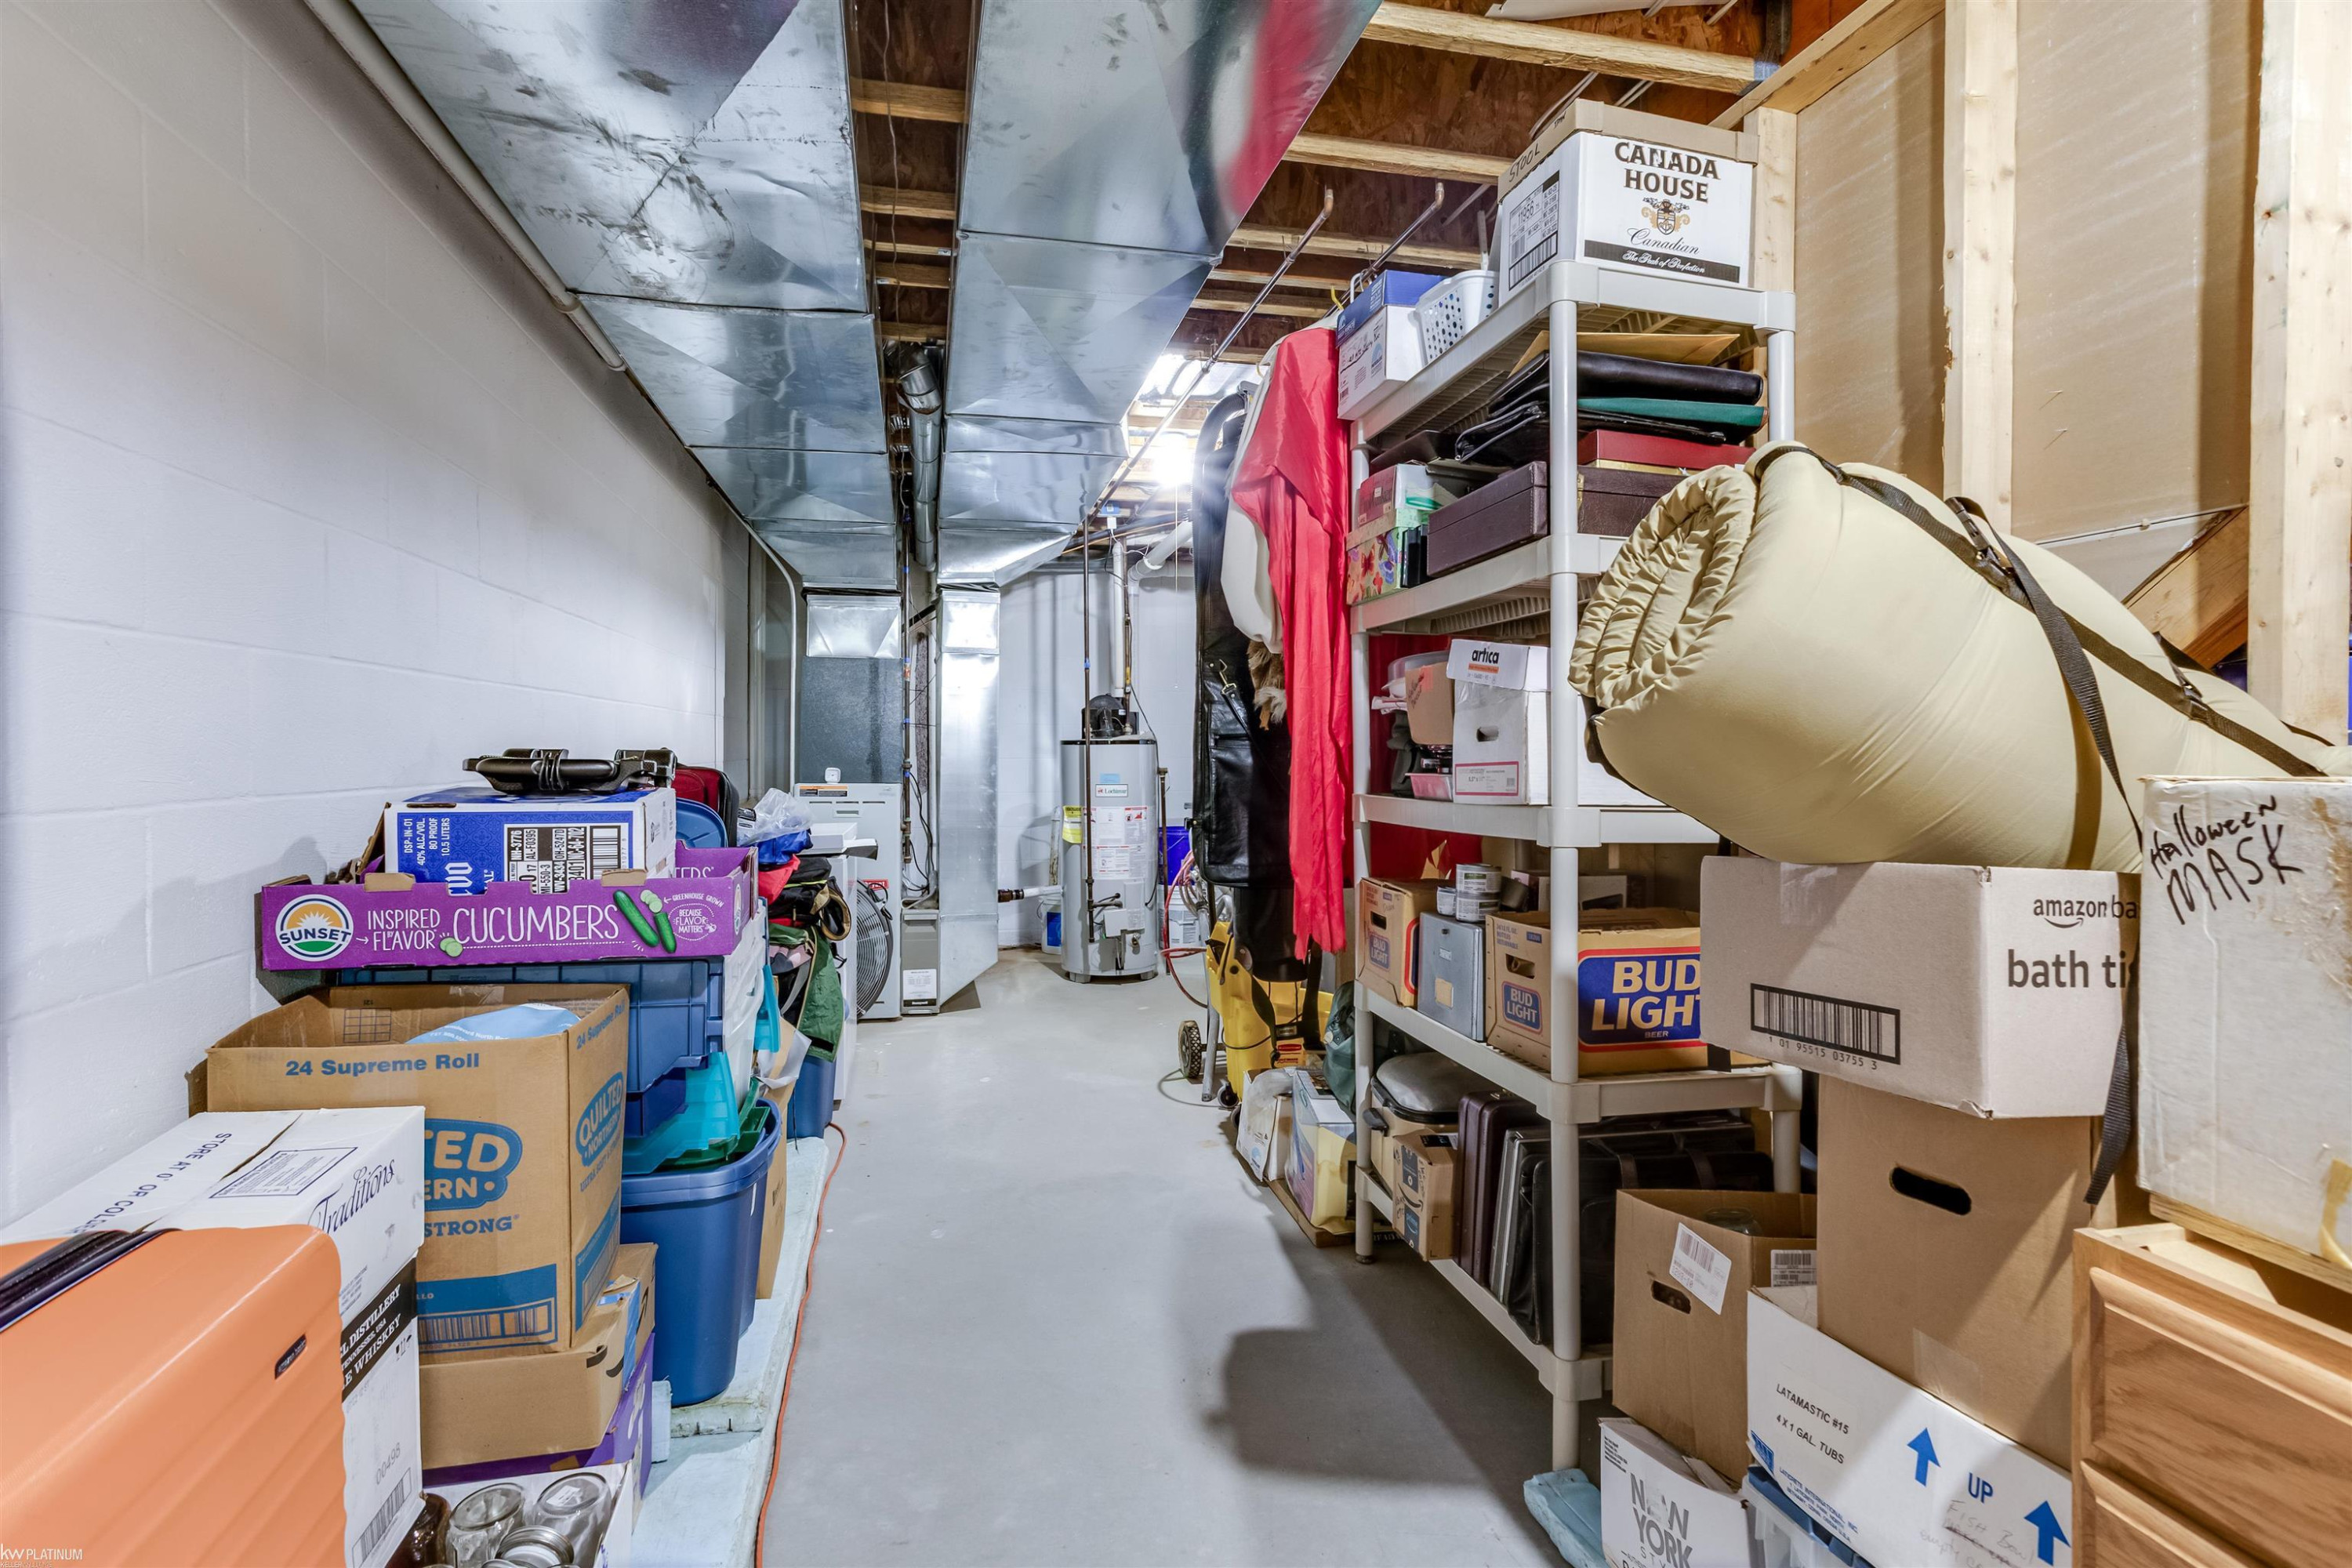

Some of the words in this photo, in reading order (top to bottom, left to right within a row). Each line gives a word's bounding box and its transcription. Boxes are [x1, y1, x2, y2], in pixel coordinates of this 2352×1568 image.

[1508, 143, 1541, 182] STOOL
[1614, 142, 1722, 180] CANADA
[1624, 168, 1708, 204] HOUSE
[1627, 227, 1700, 256] Canadian
[1622, 250, 1639, 262] The
[1638, 252, 1659, 267] Peak
[1658, 258, 1668, 269] of
[1667, 257, 1705, 274] Perfection
[403, 818, 414, 854] DSP-IN-01
[429, 817, 437, 840] PROOF
[441, 817, 450, 840] LITERS
[2151, 795, 2277, 879] Halloween
[429, 840, 437, 850] 80
[441, 840, 450, 857] 10.5
[525, 829, 537, 860] AL-F0395
[416, 852, 426, 866] 40%
[527, 864, 537, 873] 17
[2166, 824, 2306, 925] MASK
[672, 892, 705, 902] GREENHOUSE
[706, 894, 724, 908] GROWN
[2033, 898, 2107, 918] amazon
[368, 908, 441, 931] INSPIRED
[453, 904, 618, 945] CUCUMBERS
[676, 916, 706, 926] FLAVOR
[279, 927, 352, 945] SUNSET
[373, 930, 436, 951] FLAVOR
[1373, 937, 1387, 951] BUD
[1370, 946, 1388, 964] LIGHT
[1613, 959, 1700, 993] BUD
[2008, 949, 2089, 989] bath
[2101, 950, 2127, 989] ti
[1510, 988, 1533, 1007] BUD
[1507, 1001, 1537, 1023] LIGHT
[1645, 1030, 1668, 1039] BEER
[285, 1060, 314, 1076] 24
[321, 1058, 427, 1078] Supreme
[435, 1053, 480, 1069] Roll
[1779, 1039, 1790, 1049] 01
[1796, 1043, 1826, 1058] 95515
[1832, 1051, 1864, 1067] 03755
[1871, 1061, 1878, 1070] 3
[579, 1078, 622, 1147] QUILTED
[186, 1133, 233, 1160] STORE
[169, 1160, 192, 1172] AT
[129, 1184, 158, 1198] OR
[307, 1159, 395, 1235] Traditions
[349, 1283, 401, 1348] DISTILLERY
[376, 1318, 387, 1334] USA
[354, 1313, 401, 1374] WHISKEY
[1777, 1384, 1831, 1424] LATAMASTIC
[1832, 1417, 1849, 1435] #15
[1776, 1414, 1781, 1423] 4
[1781, 1417, 1788, 1428] X
[1790, 1422, 1794, 1432] 1
[1819, 1441, 1846, 1465] TUBS
[1968, 1472, 1994, 1504] UP
[1630, 1472, 1690, 1541] NW
[1633, 1507, 1693, 1568] YORK
